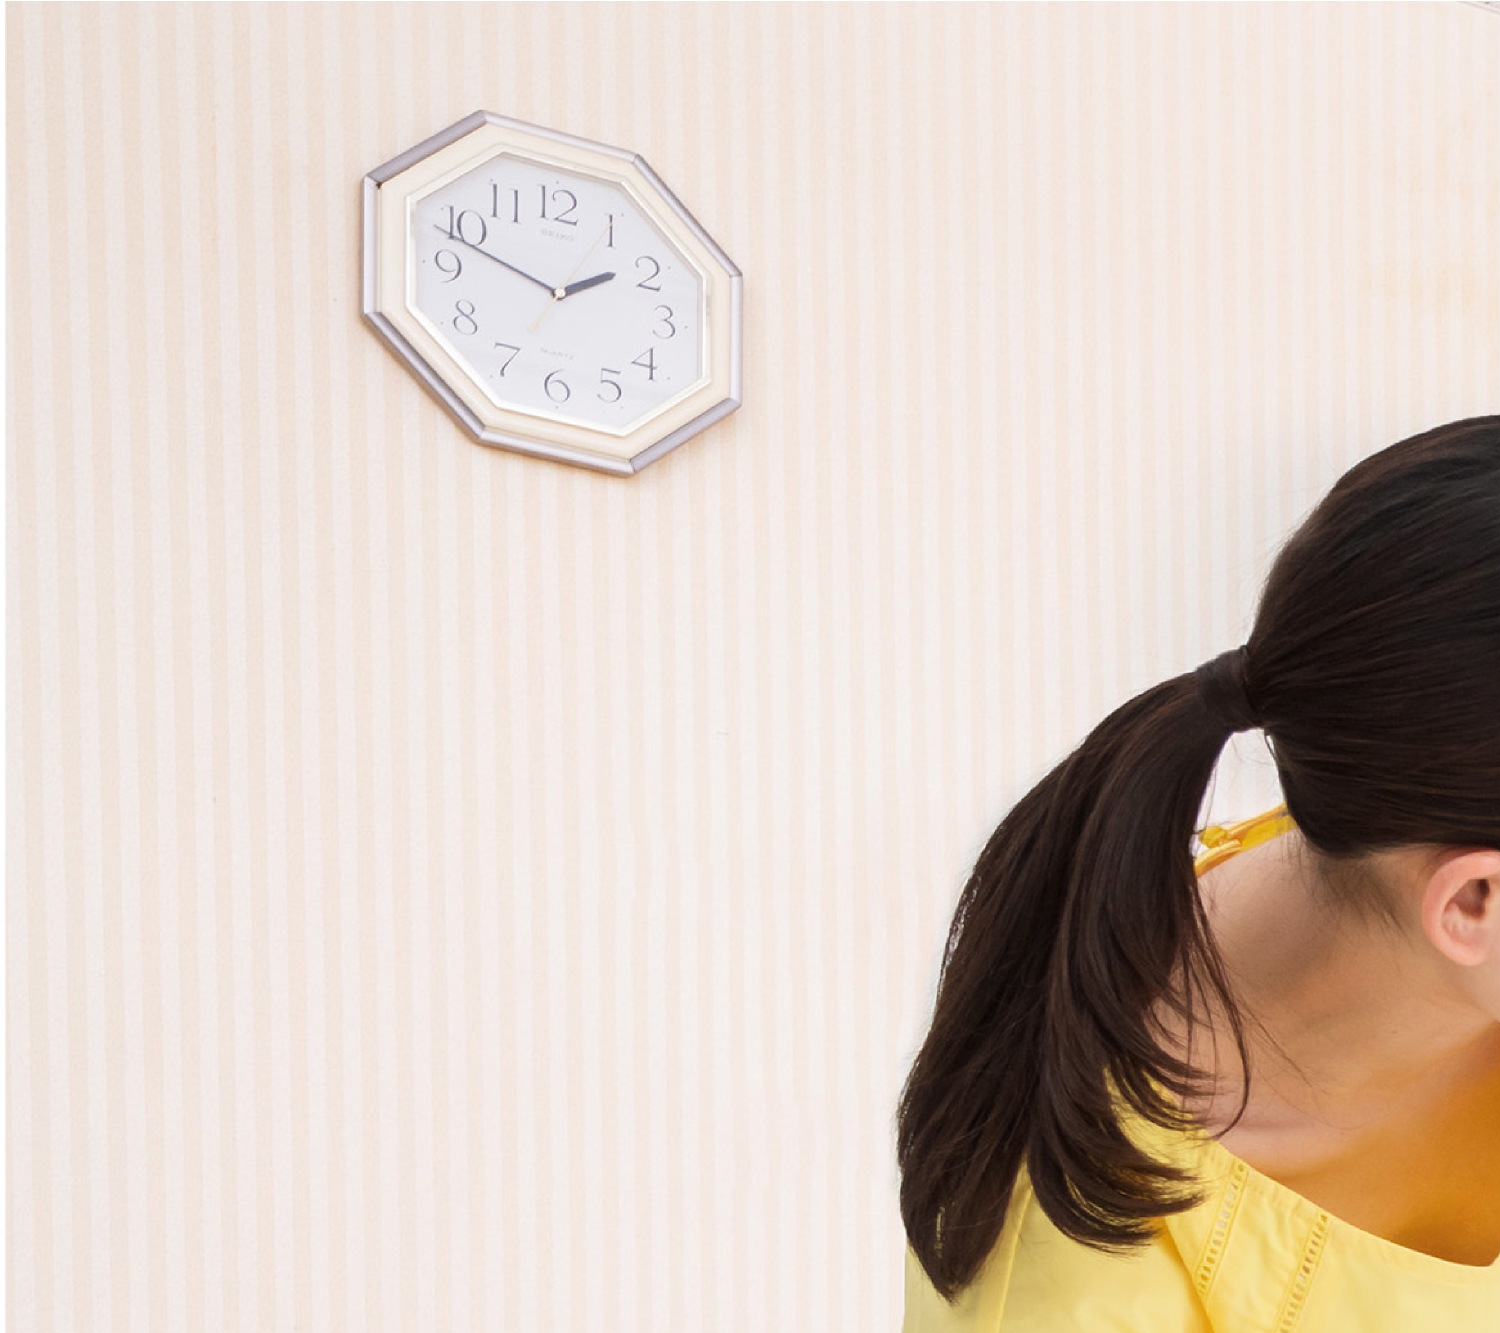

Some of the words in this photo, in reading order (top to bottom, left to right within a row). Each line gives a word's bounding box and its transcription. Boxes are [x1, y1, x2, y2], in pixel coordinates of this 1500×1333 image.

[490, 183, 522, 224] 11
[538, 185, 579, 226] 12
[448, 205, 487, 247] 10
[606, 213, 616, 248] 1
[434, 248, 462, 283] 9
[635, 255, 662, 292] 2
[452, 299, 478, 335] 8
[652, 304, 676, 339] 3
[494, 342, 521, 377] 7
[631, 347, 658, 381] 4
[544, 370, 571, 403] 6
[597, 368, 622, 403] 5
